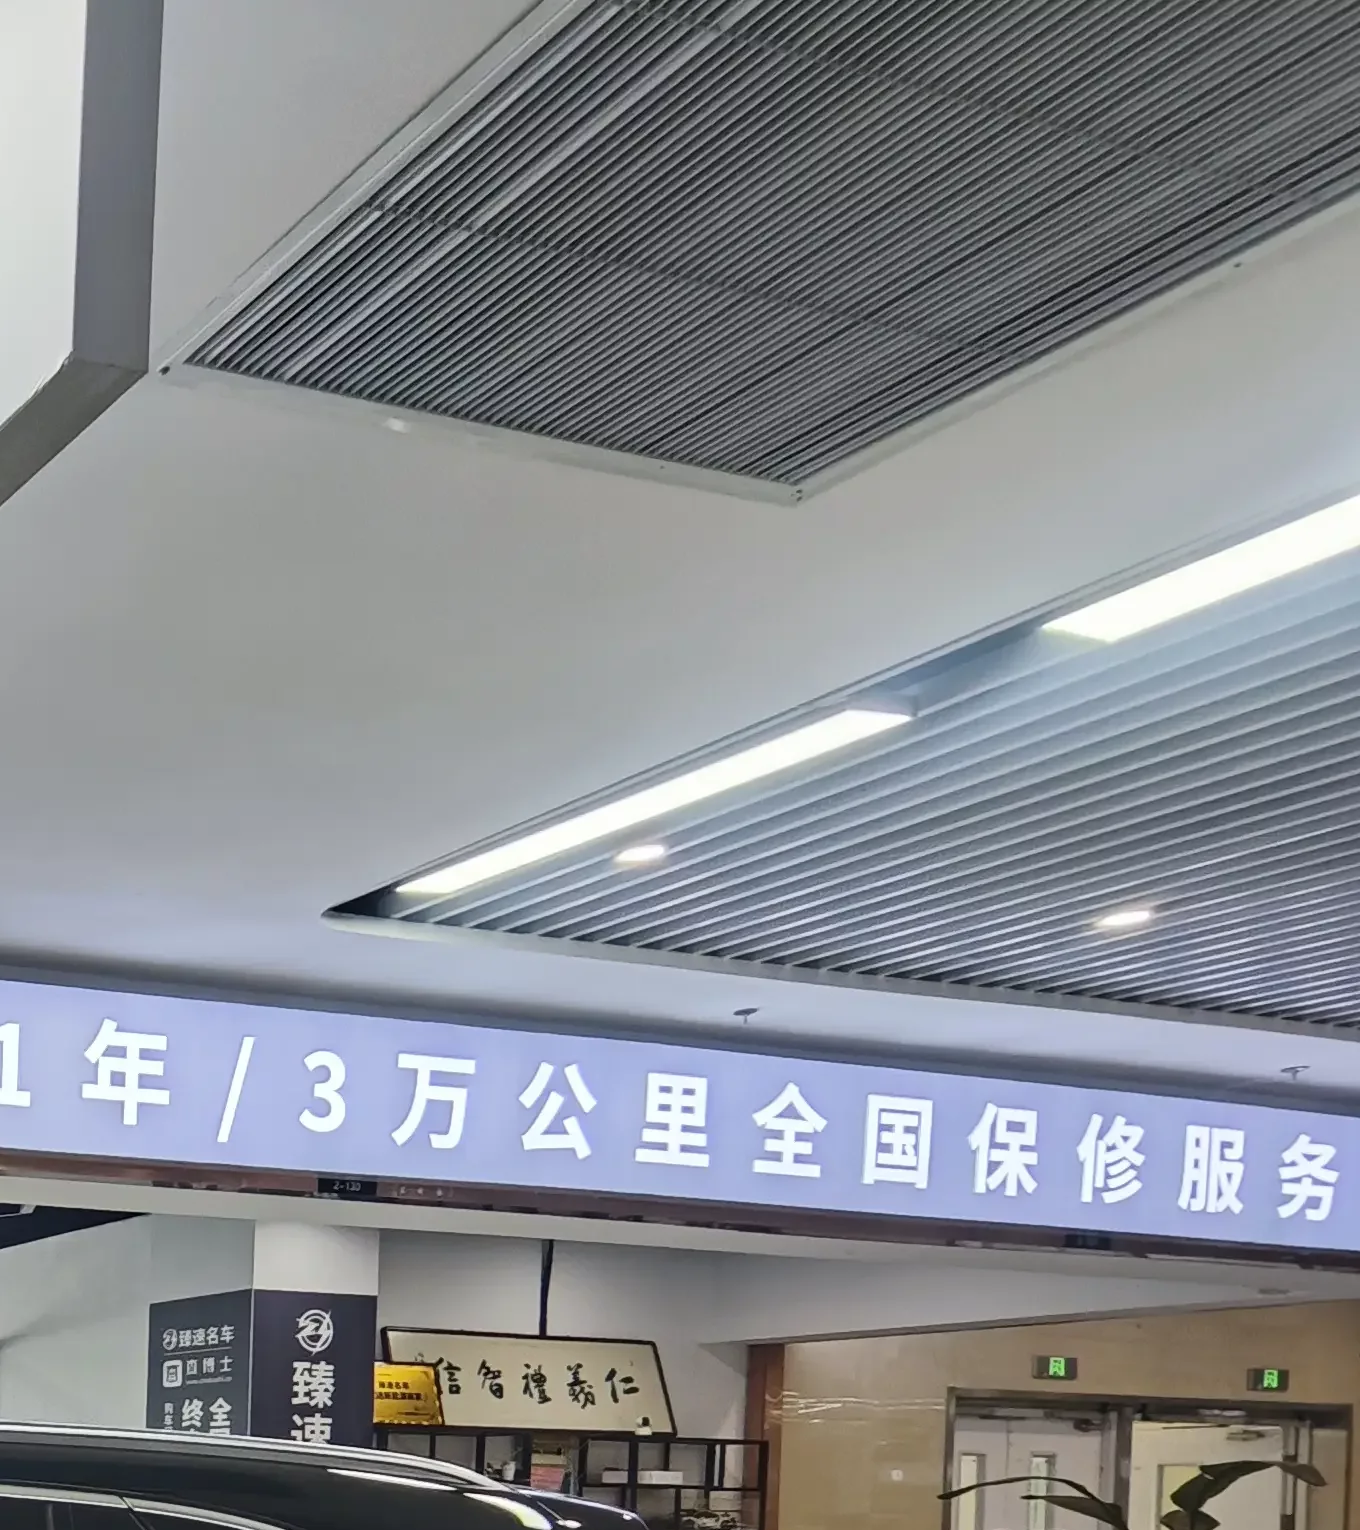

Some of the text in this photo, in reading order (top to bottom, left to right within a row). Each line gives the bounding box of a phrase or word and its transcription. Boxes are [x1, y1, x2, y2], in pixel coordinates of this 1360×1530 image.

[179, 1324, 235, 1348] 臻速名车
[208, 1397, 232, 1435] 全
